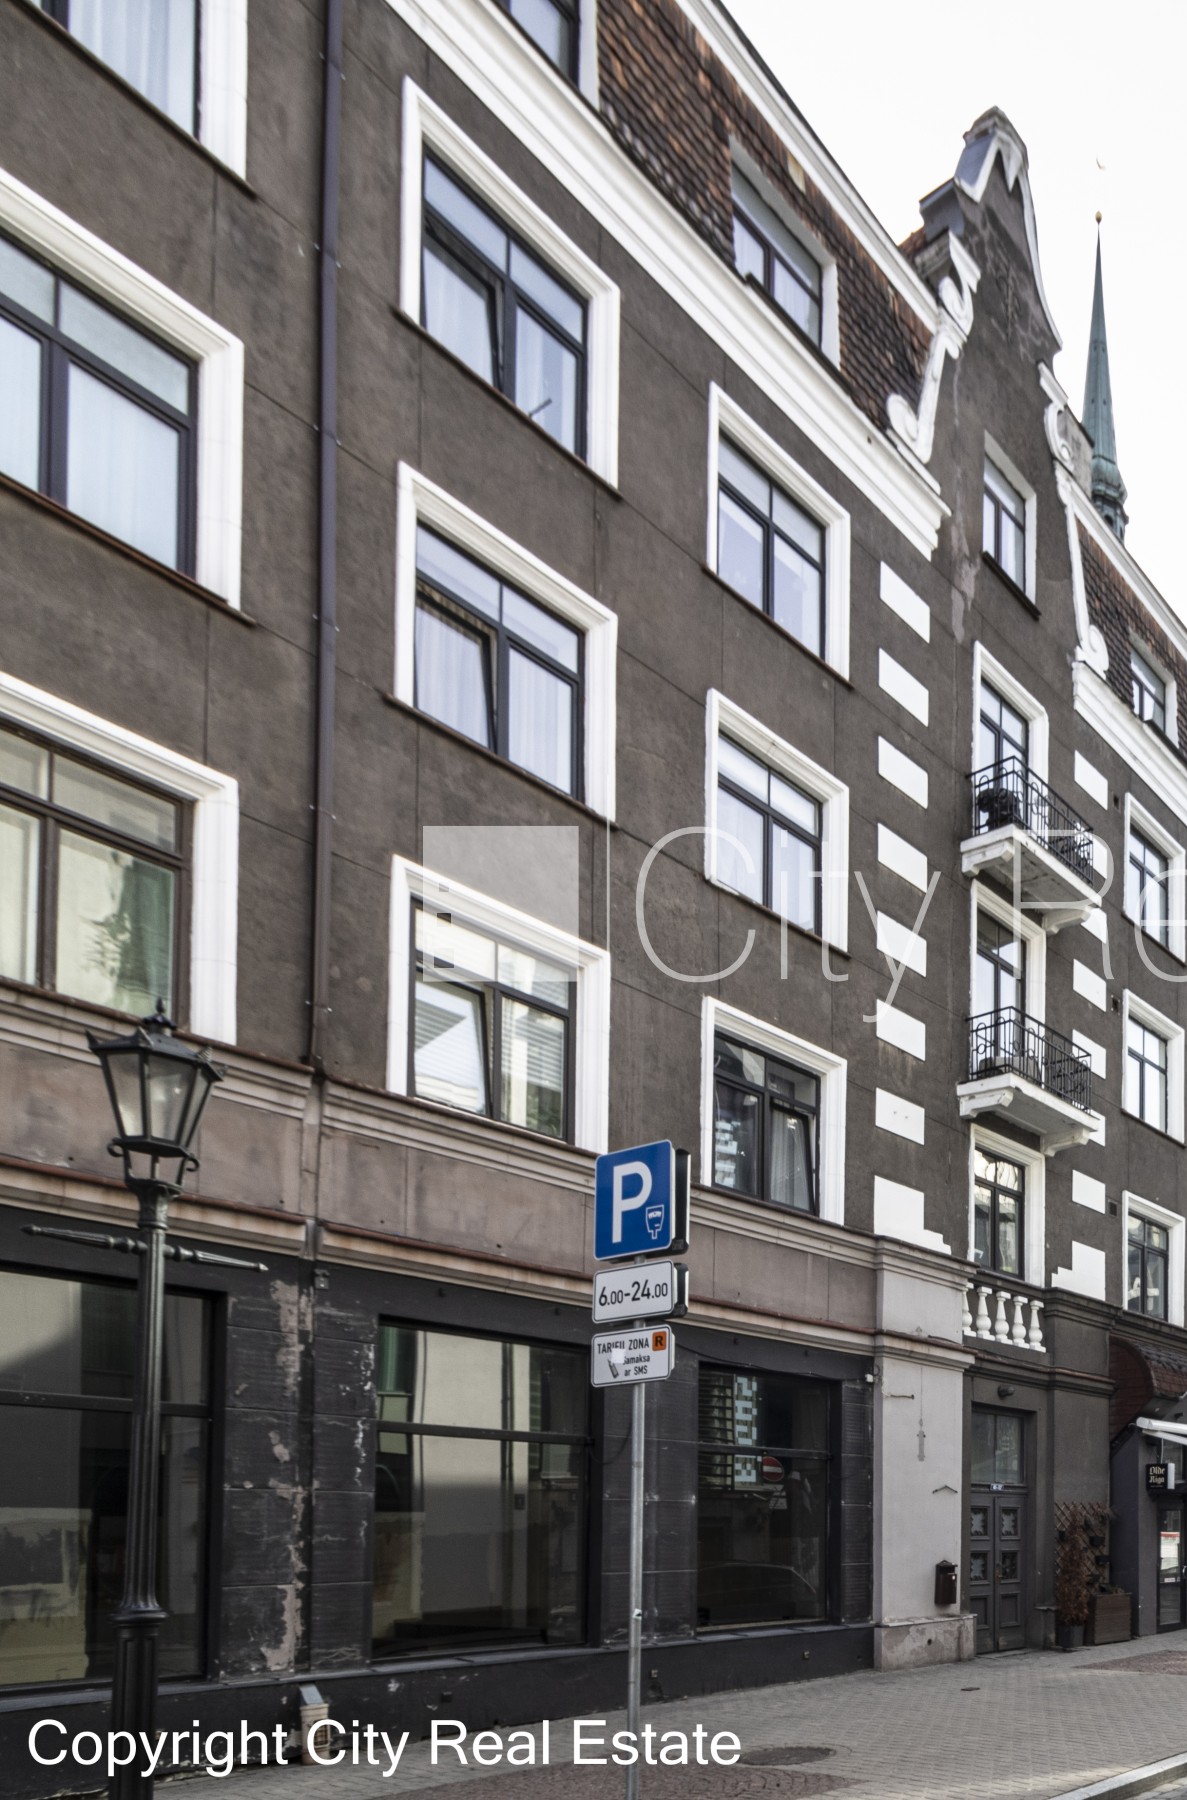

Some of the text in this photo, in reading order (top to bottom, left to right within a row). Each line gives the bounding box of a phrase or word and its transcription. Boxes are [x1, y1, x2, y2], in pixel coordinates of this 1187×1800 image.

[612, 1160, 652, 1243] P
[598, 1279, 668, 1307] 6.00-24.00
[628, 1337, 650, 1351] ZONA
[655, 1335, 664, 1347] R
[624, 1365, 648, 1377] ar SMS
